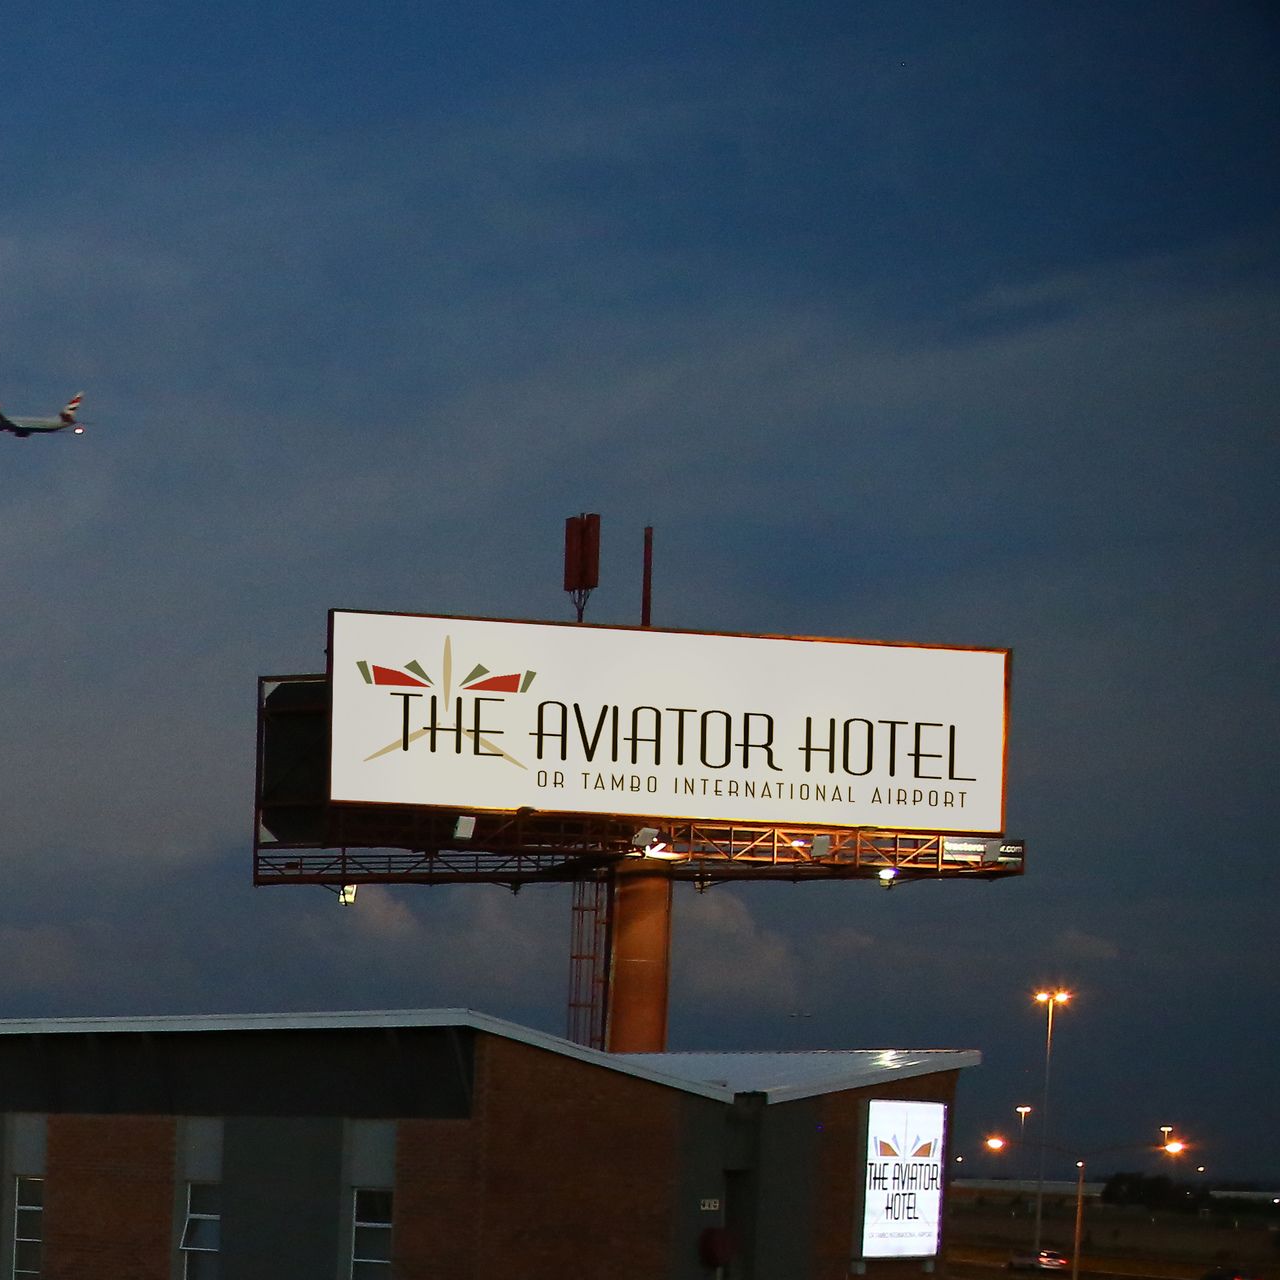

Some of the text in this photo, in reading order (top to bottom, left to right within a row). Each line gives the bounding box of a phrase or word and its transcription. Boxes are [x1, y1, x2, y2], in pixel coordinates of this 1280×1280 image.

[390, 692, 977, 782] THE AVIATOR HOTEL
[537, 770, 968, 808] OR TAMBO INTERNATIONAL AIRPORT
[868, 1163, 940, 1190] THE AVIATOR
[885, 1193, 920, 1220] HOTEL
